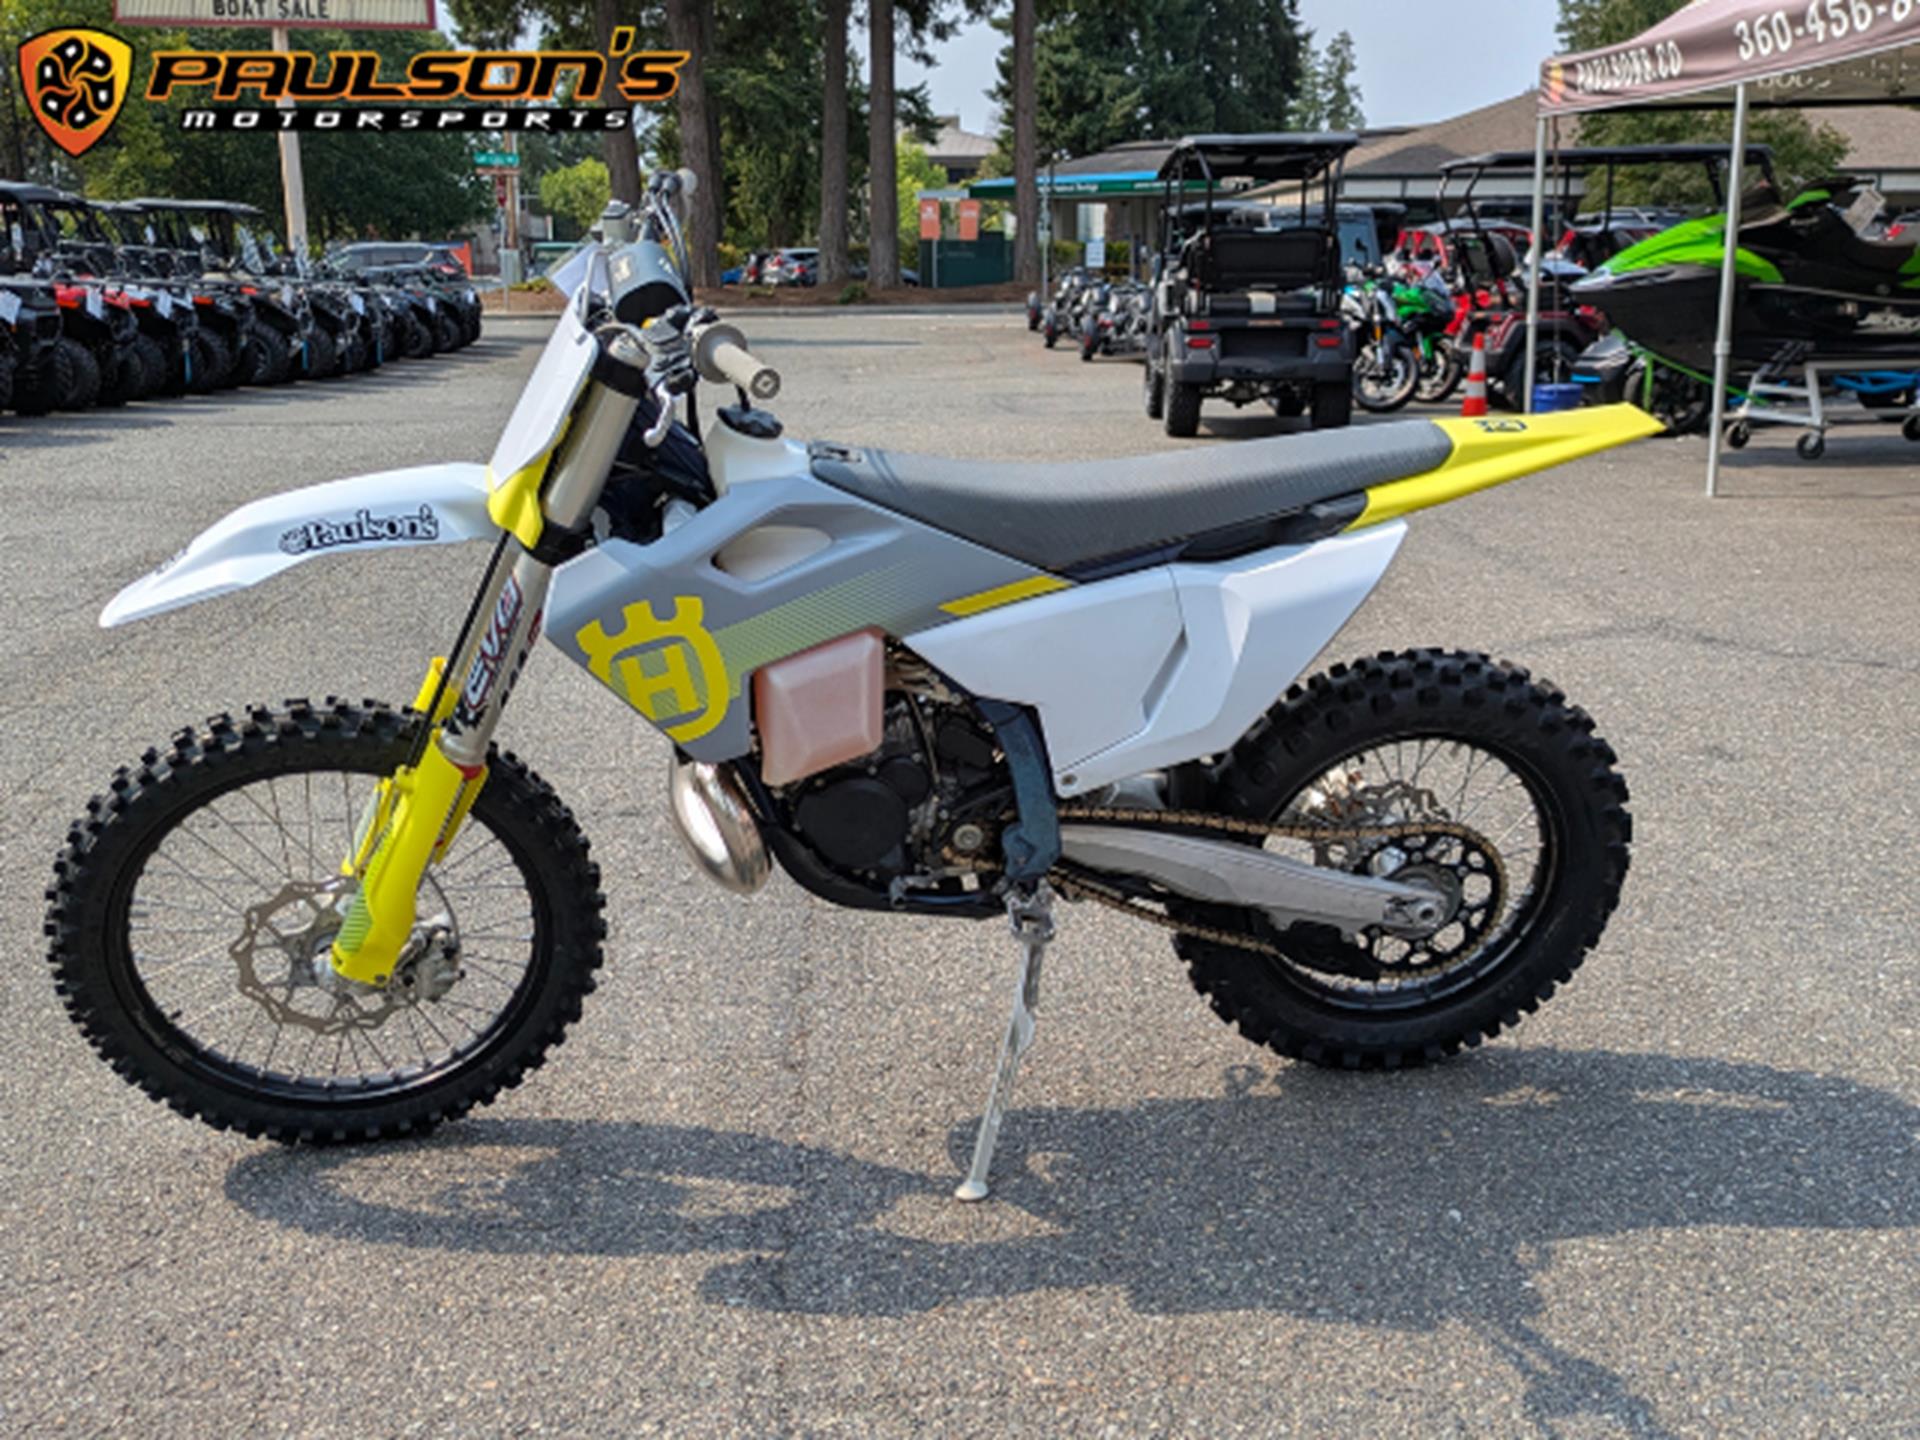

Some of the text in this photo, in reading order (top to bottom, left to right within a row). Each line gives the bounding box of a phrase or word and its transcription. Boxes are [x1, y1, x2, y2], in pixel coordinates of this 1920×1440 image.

[212, 0, 330, 19] BOAT SALE
[304, 503, 439, 550] Paulson's
